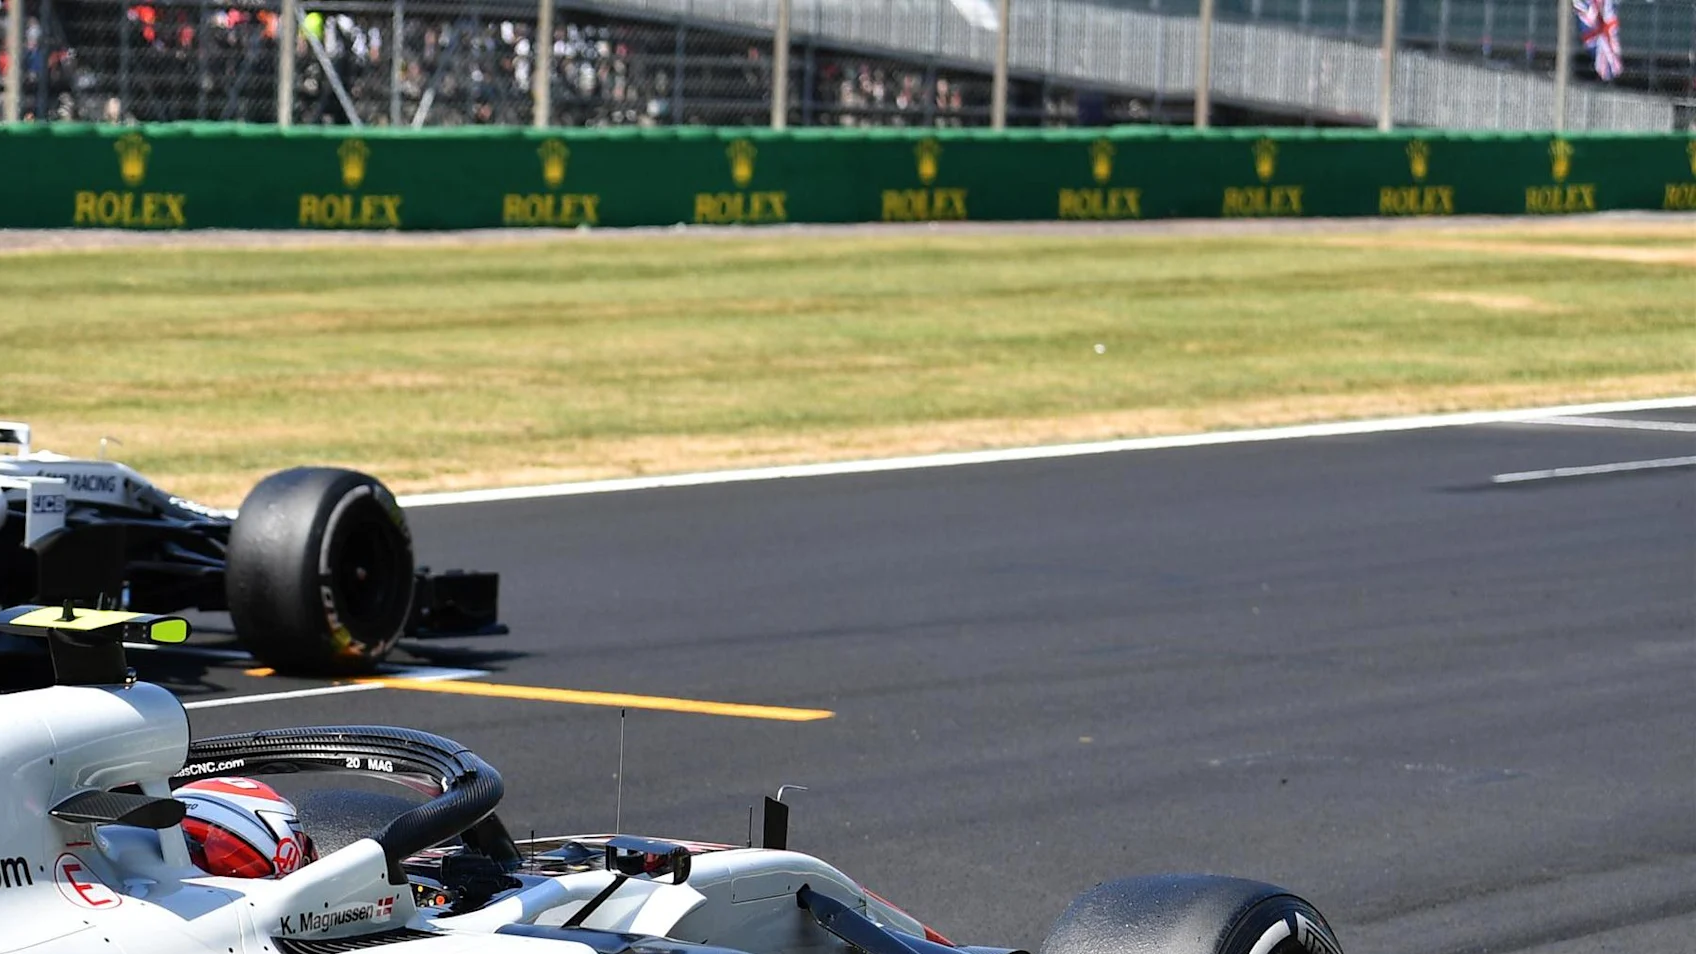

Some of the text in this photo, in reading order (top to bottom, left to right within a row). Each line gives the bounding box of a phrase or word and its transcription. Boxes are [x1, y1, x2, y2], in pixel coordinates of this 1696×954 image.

[74, 191, 184, 224] ROLEX
[298, 194, 401, 224] ROLEX
[502, 194, 598, 222] ROLEX
[694, 192, 785, 220] ROLEX
[881, 190, 966, 219] ROLEX
[1058, 189, 1139, 216] ROLEX
[1223, 187, 1300, 212] ROLEX
[1379, 185, 1453, 213] ROLEX
[1525, 184, 1595, 212] ROLEX
[71, 473, 117, 493] RACING
[173, 758, 245, 777] asCNC.com
[345, 757, 394, 773] 20 MAG
[280, 904, 374, 936] K. Magnussen
